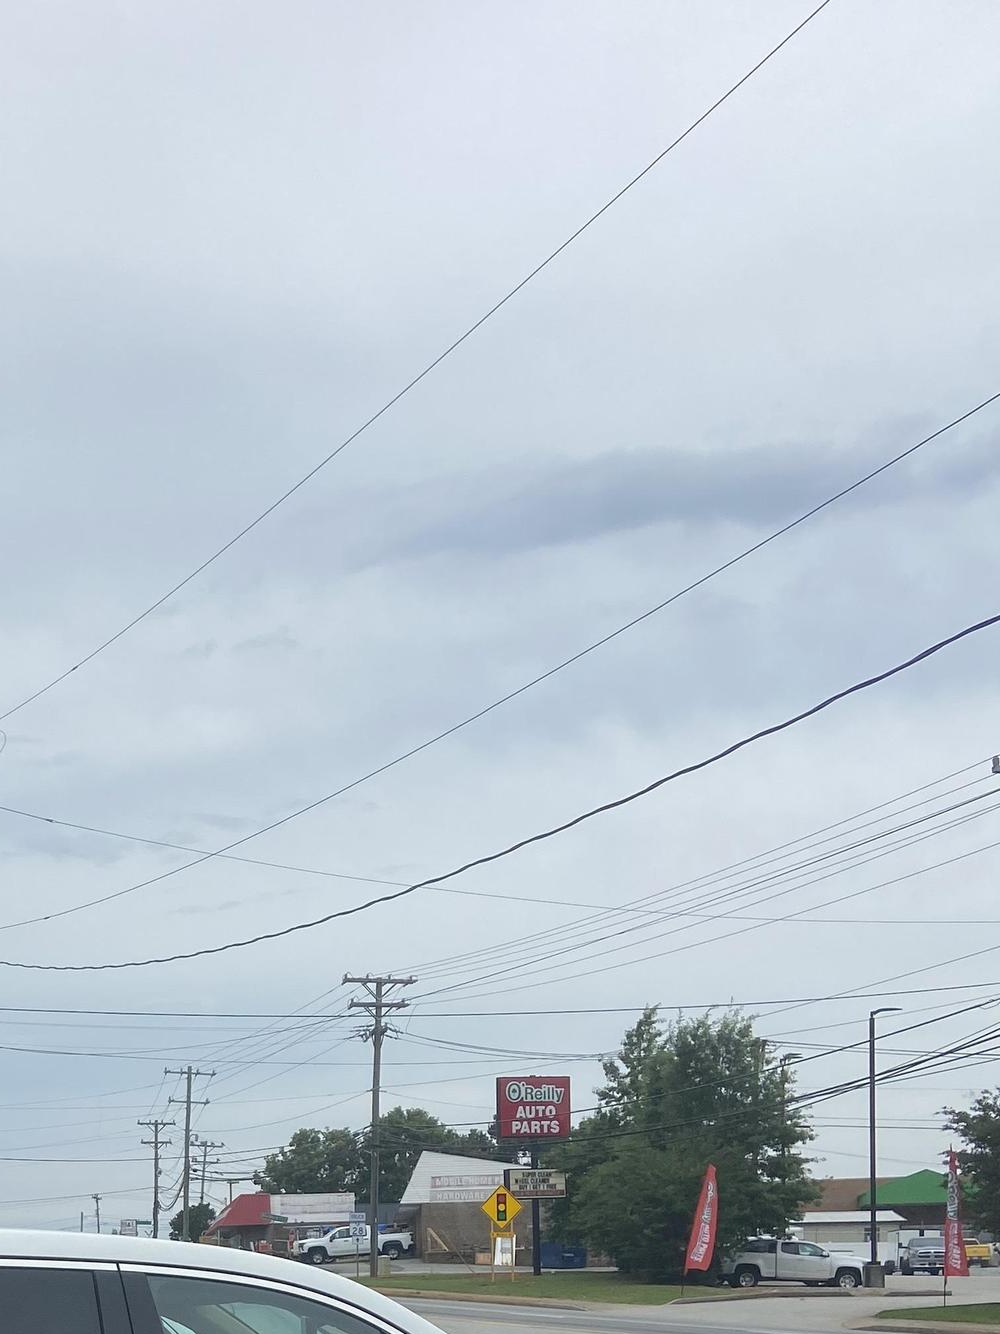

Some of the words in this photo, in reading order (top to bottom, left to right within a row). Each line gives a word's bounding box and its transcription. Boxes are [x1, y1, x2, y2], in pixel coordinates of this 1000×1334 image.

[506, 1081, 564, 1103] O'Reilly
[516, 1105, 556, 1118] AUTO
[511, 1121, 560, 1134] PARTS
[437, 1191, 485, 1200] HARDWARE
[352, 1227, 364, 1235] 28
